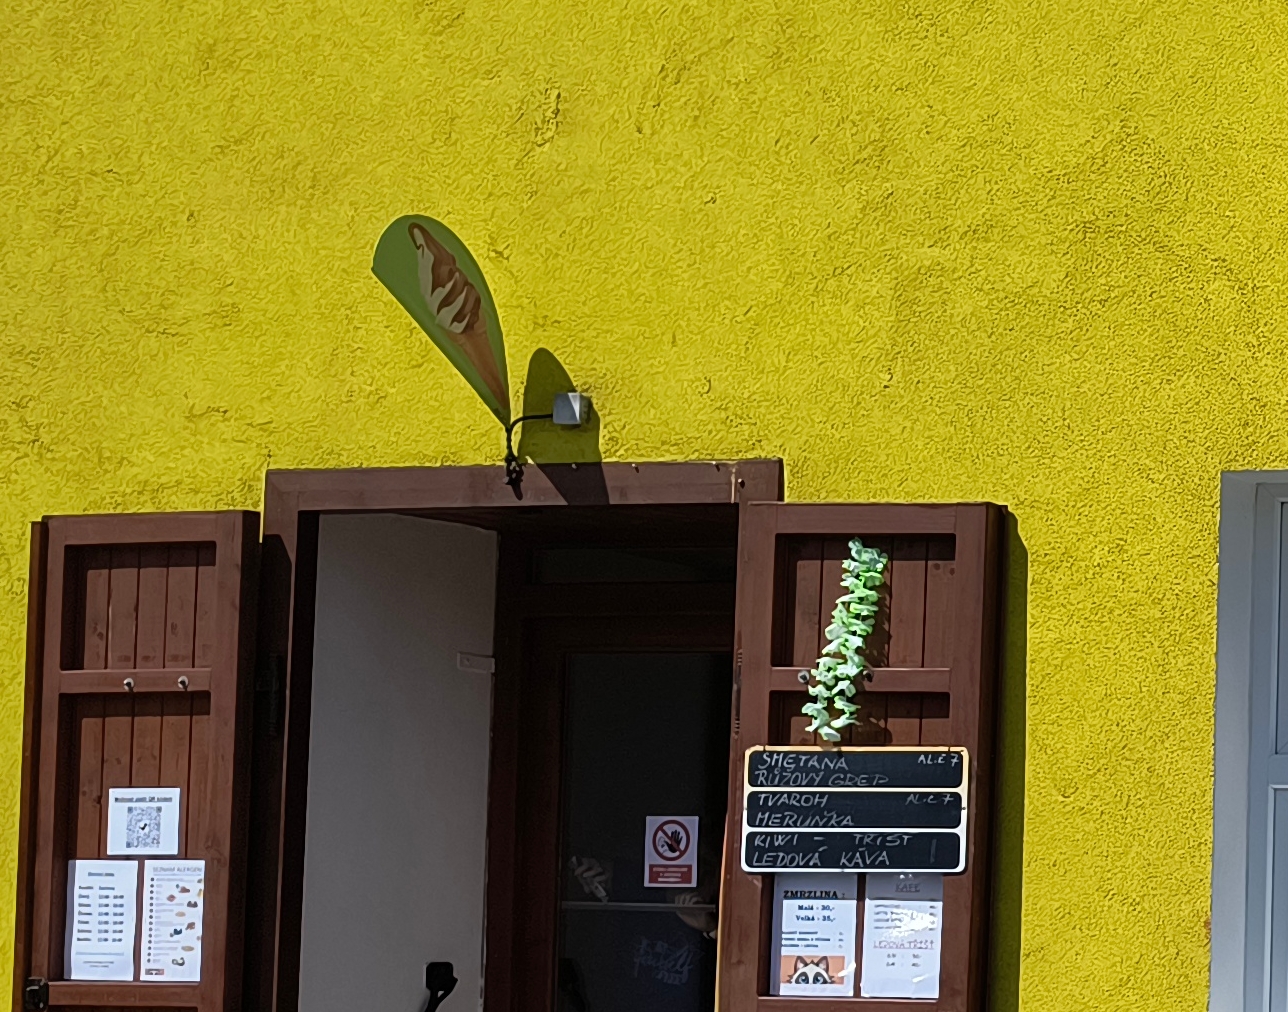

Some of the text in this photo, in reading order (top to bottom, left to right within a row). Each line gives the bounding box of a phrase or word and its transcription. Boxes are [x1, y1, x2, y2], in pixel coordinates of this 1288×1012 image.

[757, 752, 850, 770] SMETANA
[949, 753, 960, 767] 7
[828, 772, 890, 786] GREP
[757, 793, 829, 807] TVAROH
[753, 833, 799, 848] KIWI
[752, 846, 891, 868] LEDOVÁ KÁVA
[783, 890, 838, 899] ZMRZLINA
